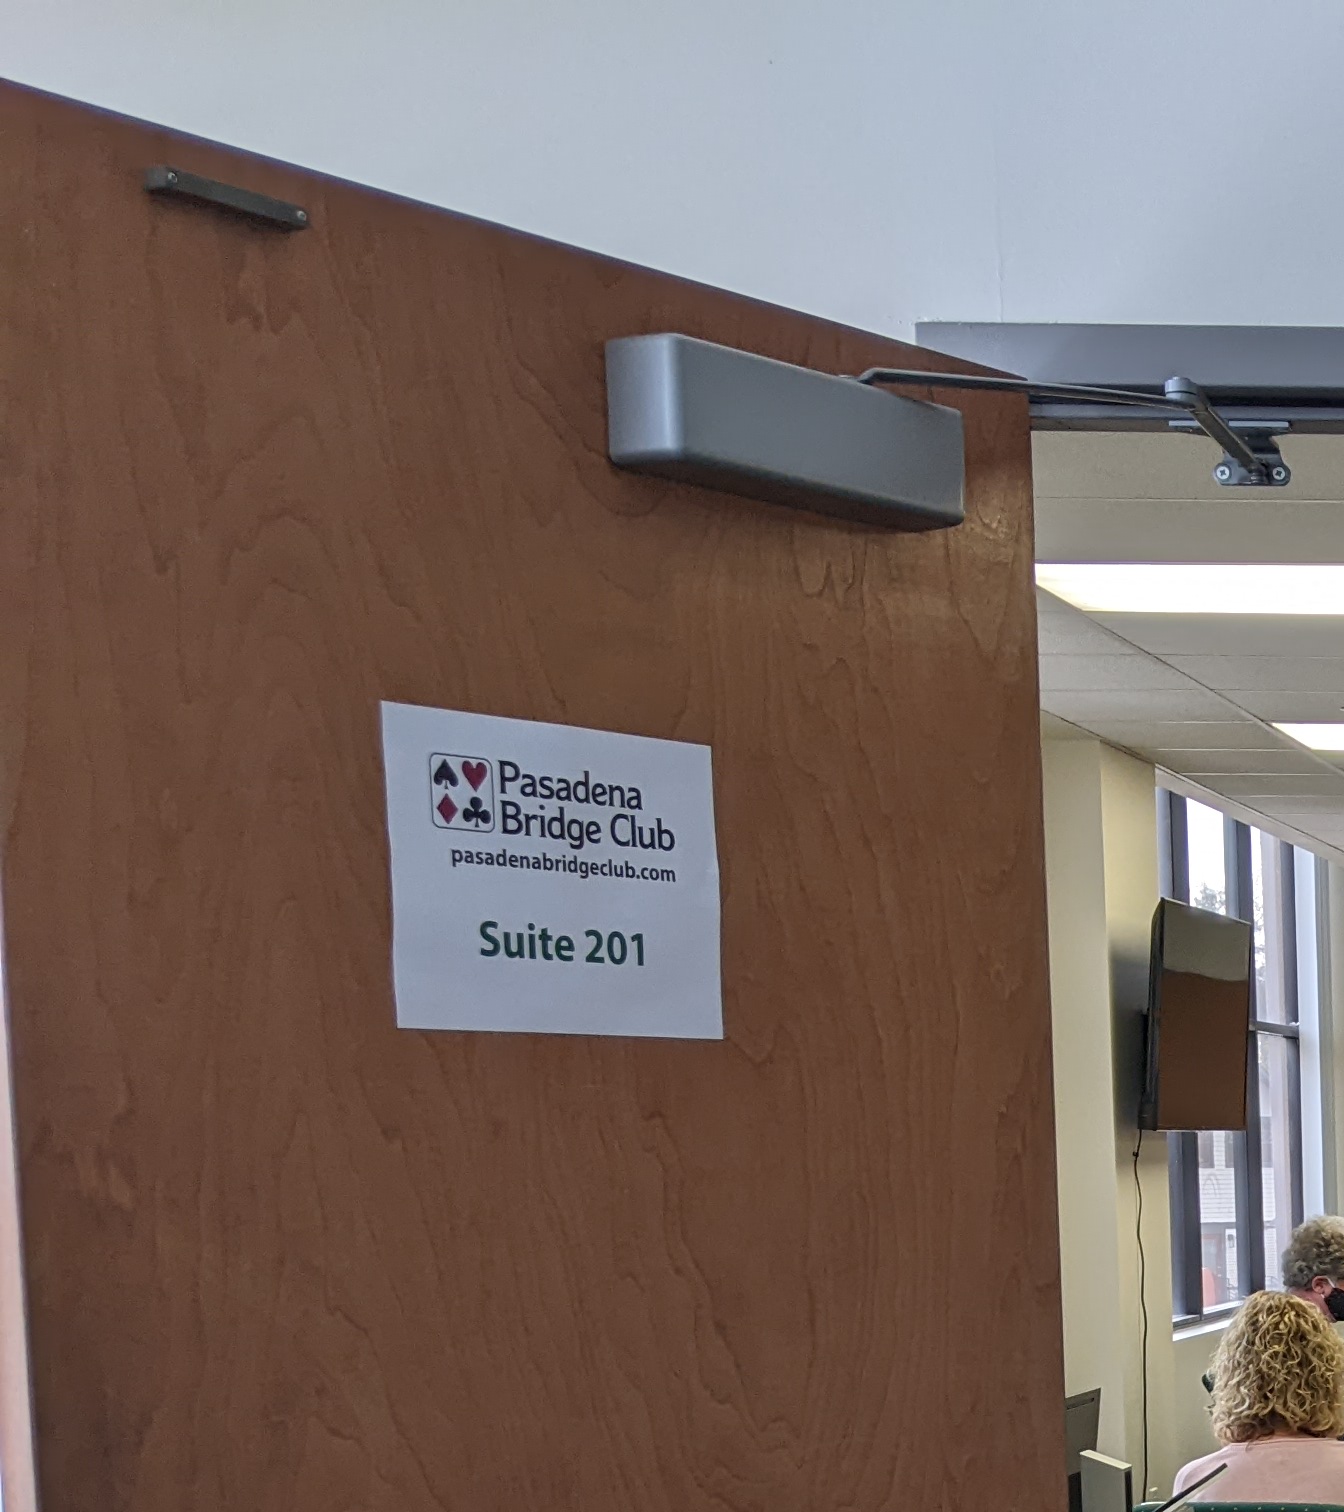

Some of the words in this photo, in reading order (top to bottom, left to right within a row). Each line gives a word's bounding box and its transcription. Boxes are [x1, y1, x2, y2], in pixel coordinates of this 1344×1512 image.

[498, 759, 643, 810] Pasadena
[500, 800, 601, 849] Bridge
[610, 813, 676, 851] Club
[451, 848, 676, 882] pasadenabridgeclub.com
[479, 920, 575, 962] Suite
[585, 930, 645, 966] 201
